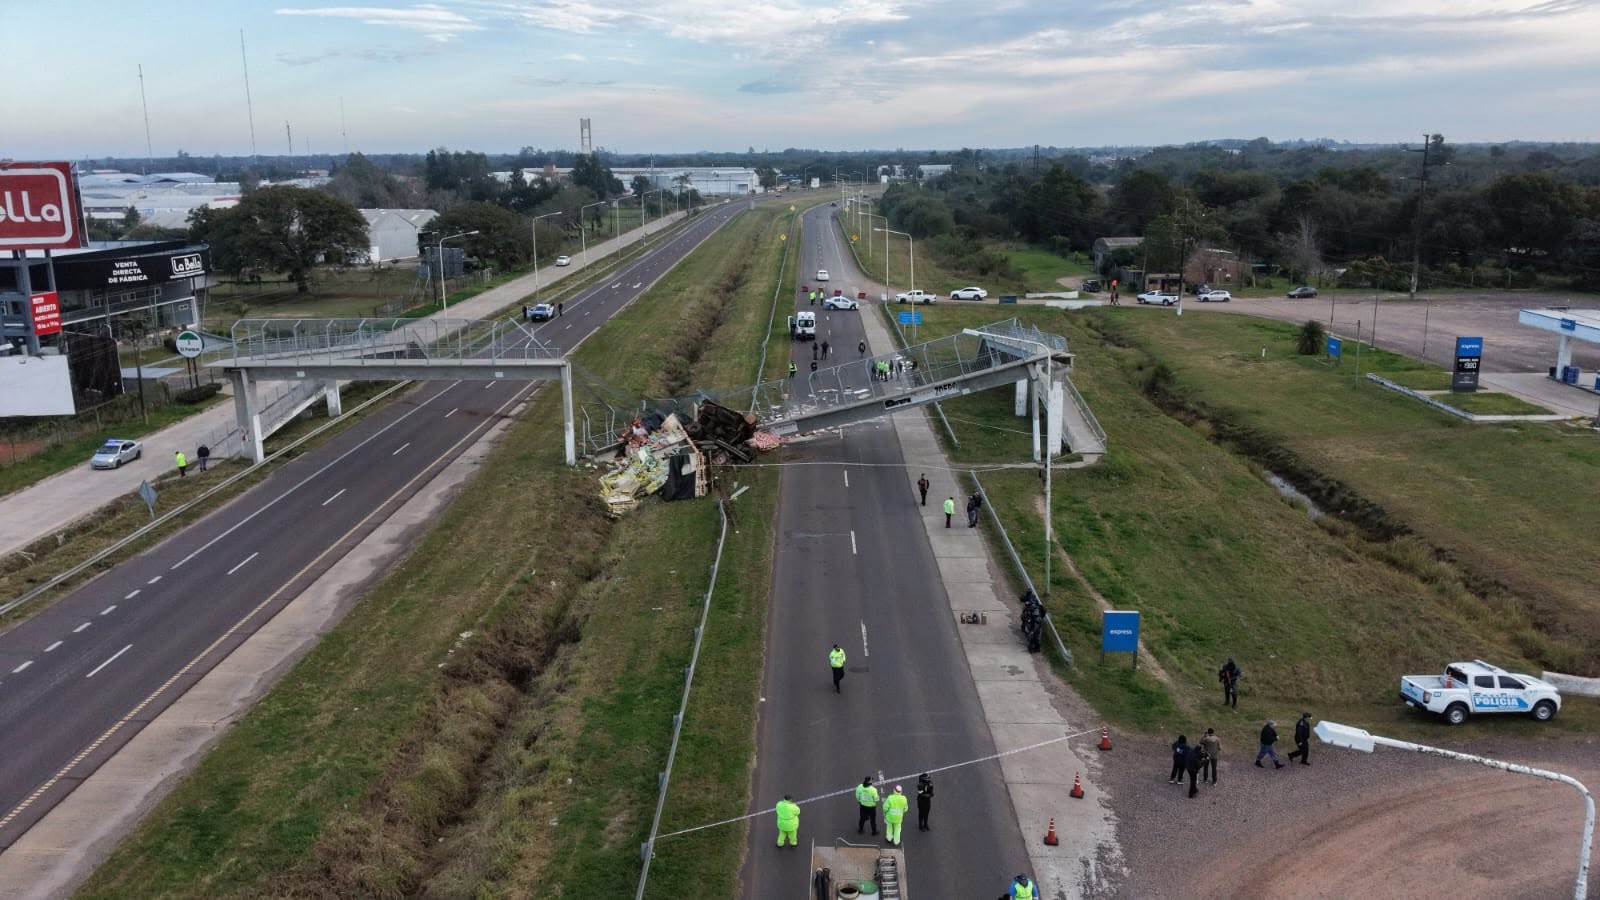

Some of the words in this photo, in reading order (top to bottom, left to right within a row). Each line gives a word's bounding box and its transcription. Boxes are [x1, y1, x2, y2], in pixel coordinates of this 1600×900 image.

[174, 259, 184, 271] La
[184, 257, 201, 270] Bella
[112, 268, 142, 276] DIRECTA
[36, 304, 56, 313] ABIERTO
